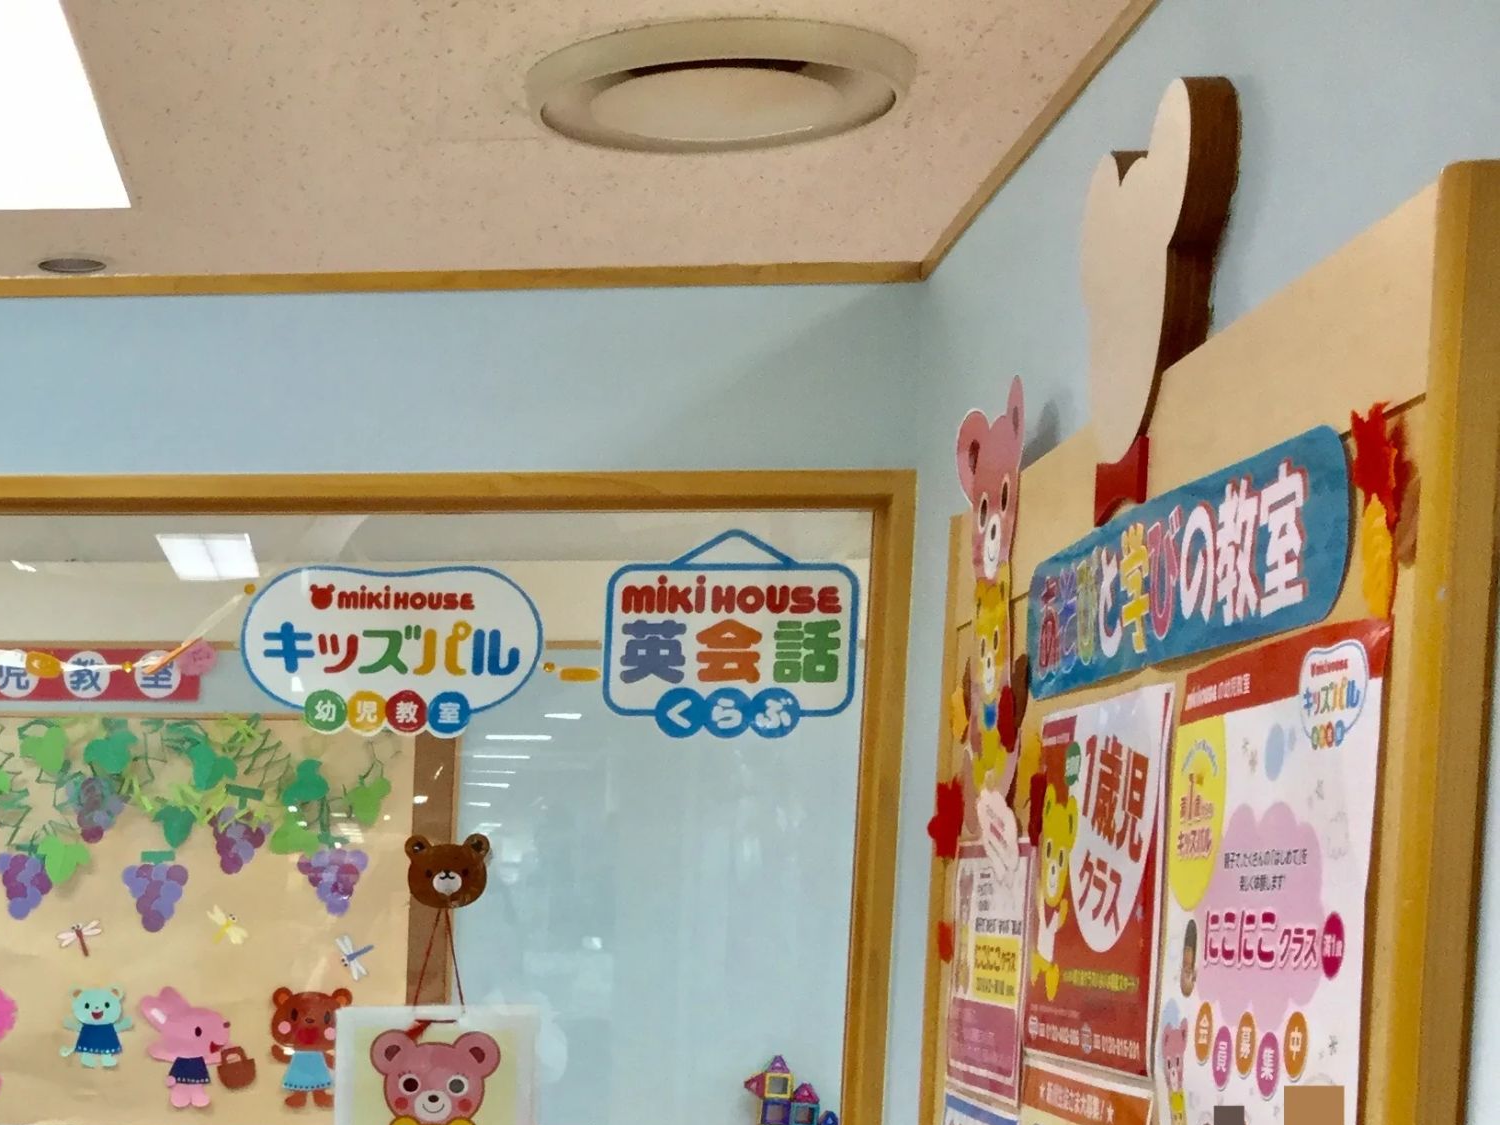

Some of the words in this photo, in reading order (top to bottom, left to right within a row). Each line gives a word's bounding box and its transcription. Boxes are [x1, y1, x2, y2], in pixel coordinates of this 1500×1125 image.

[263, 621, 521, 678] キッズパル
[619, 618, 841, 685] 英会話
[314, 699, 462, 726] 幼児教室
[666, 694, 794, 732] くらぶ
[1083, 735, 1150, 863] 1歳児
[1079, 849, 1122, 936] クラス
